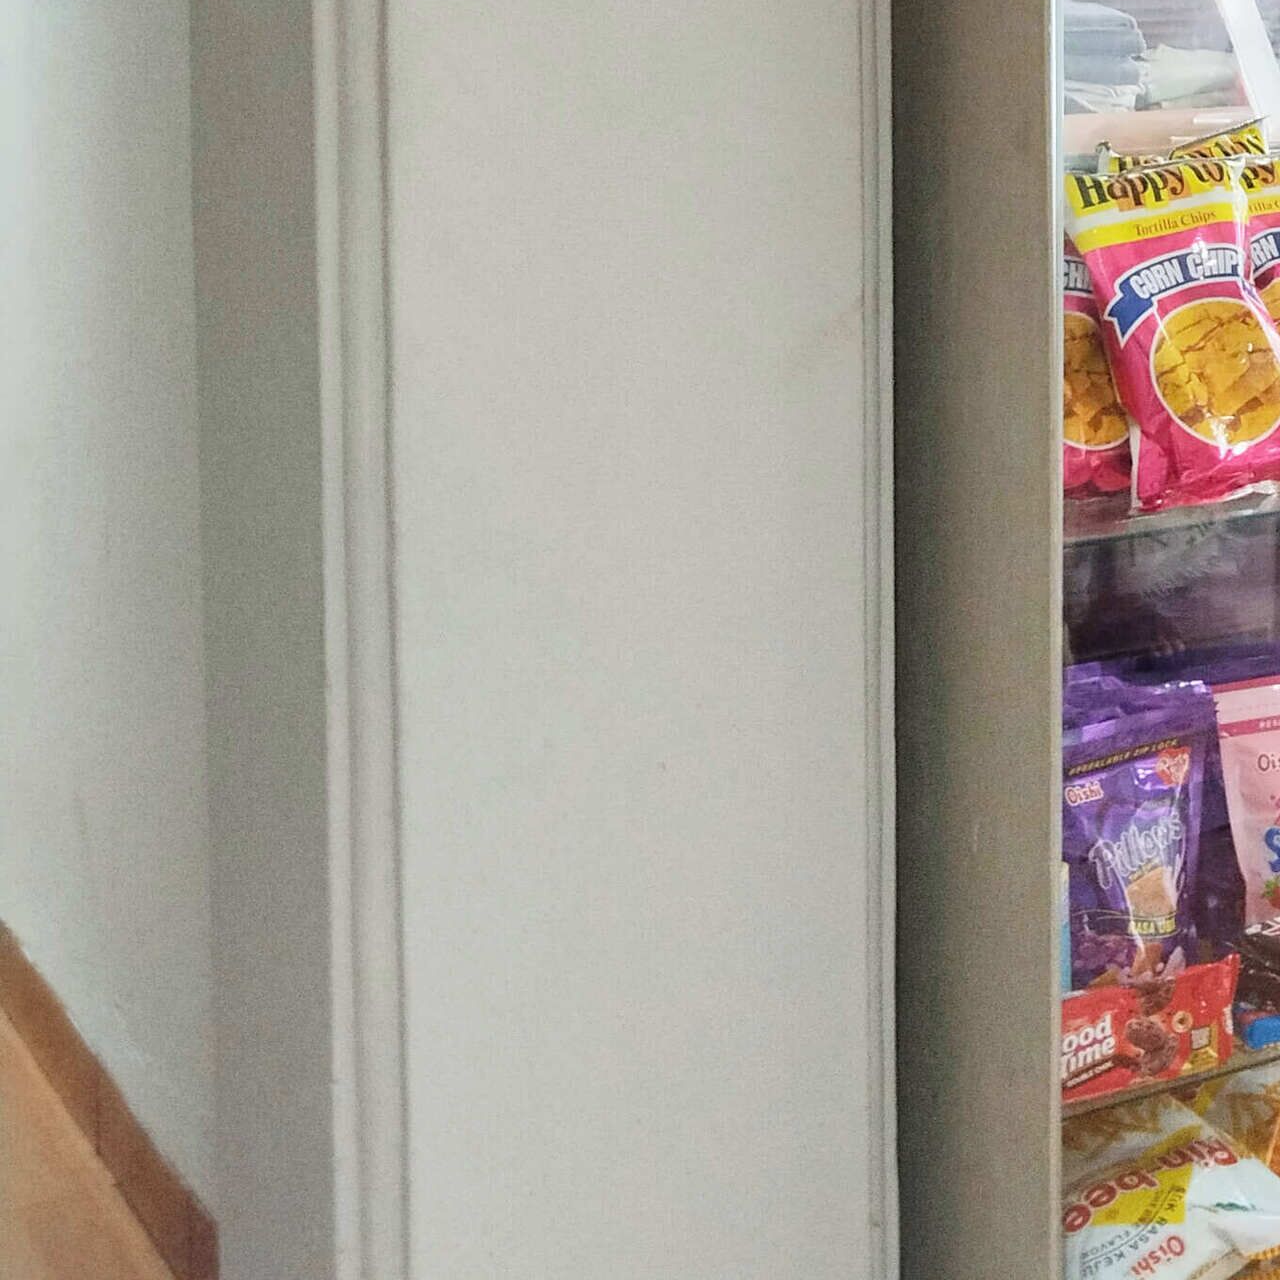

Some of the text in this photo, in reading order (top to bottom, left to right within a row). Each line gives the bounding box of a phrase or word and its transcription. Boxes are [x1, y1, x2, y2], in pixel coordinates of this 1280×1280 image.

[1075, 166, 1184, 209] Happy
[1135, 210, 1216, 237] Tortilla Chips
[1129, 257, 1181, 300] CORN
[1066, 784, 1103, 805] Oishi
[1061, 1011, 1112, 1054] ood
[1130, 1234, 1186, 1280] Oishi
